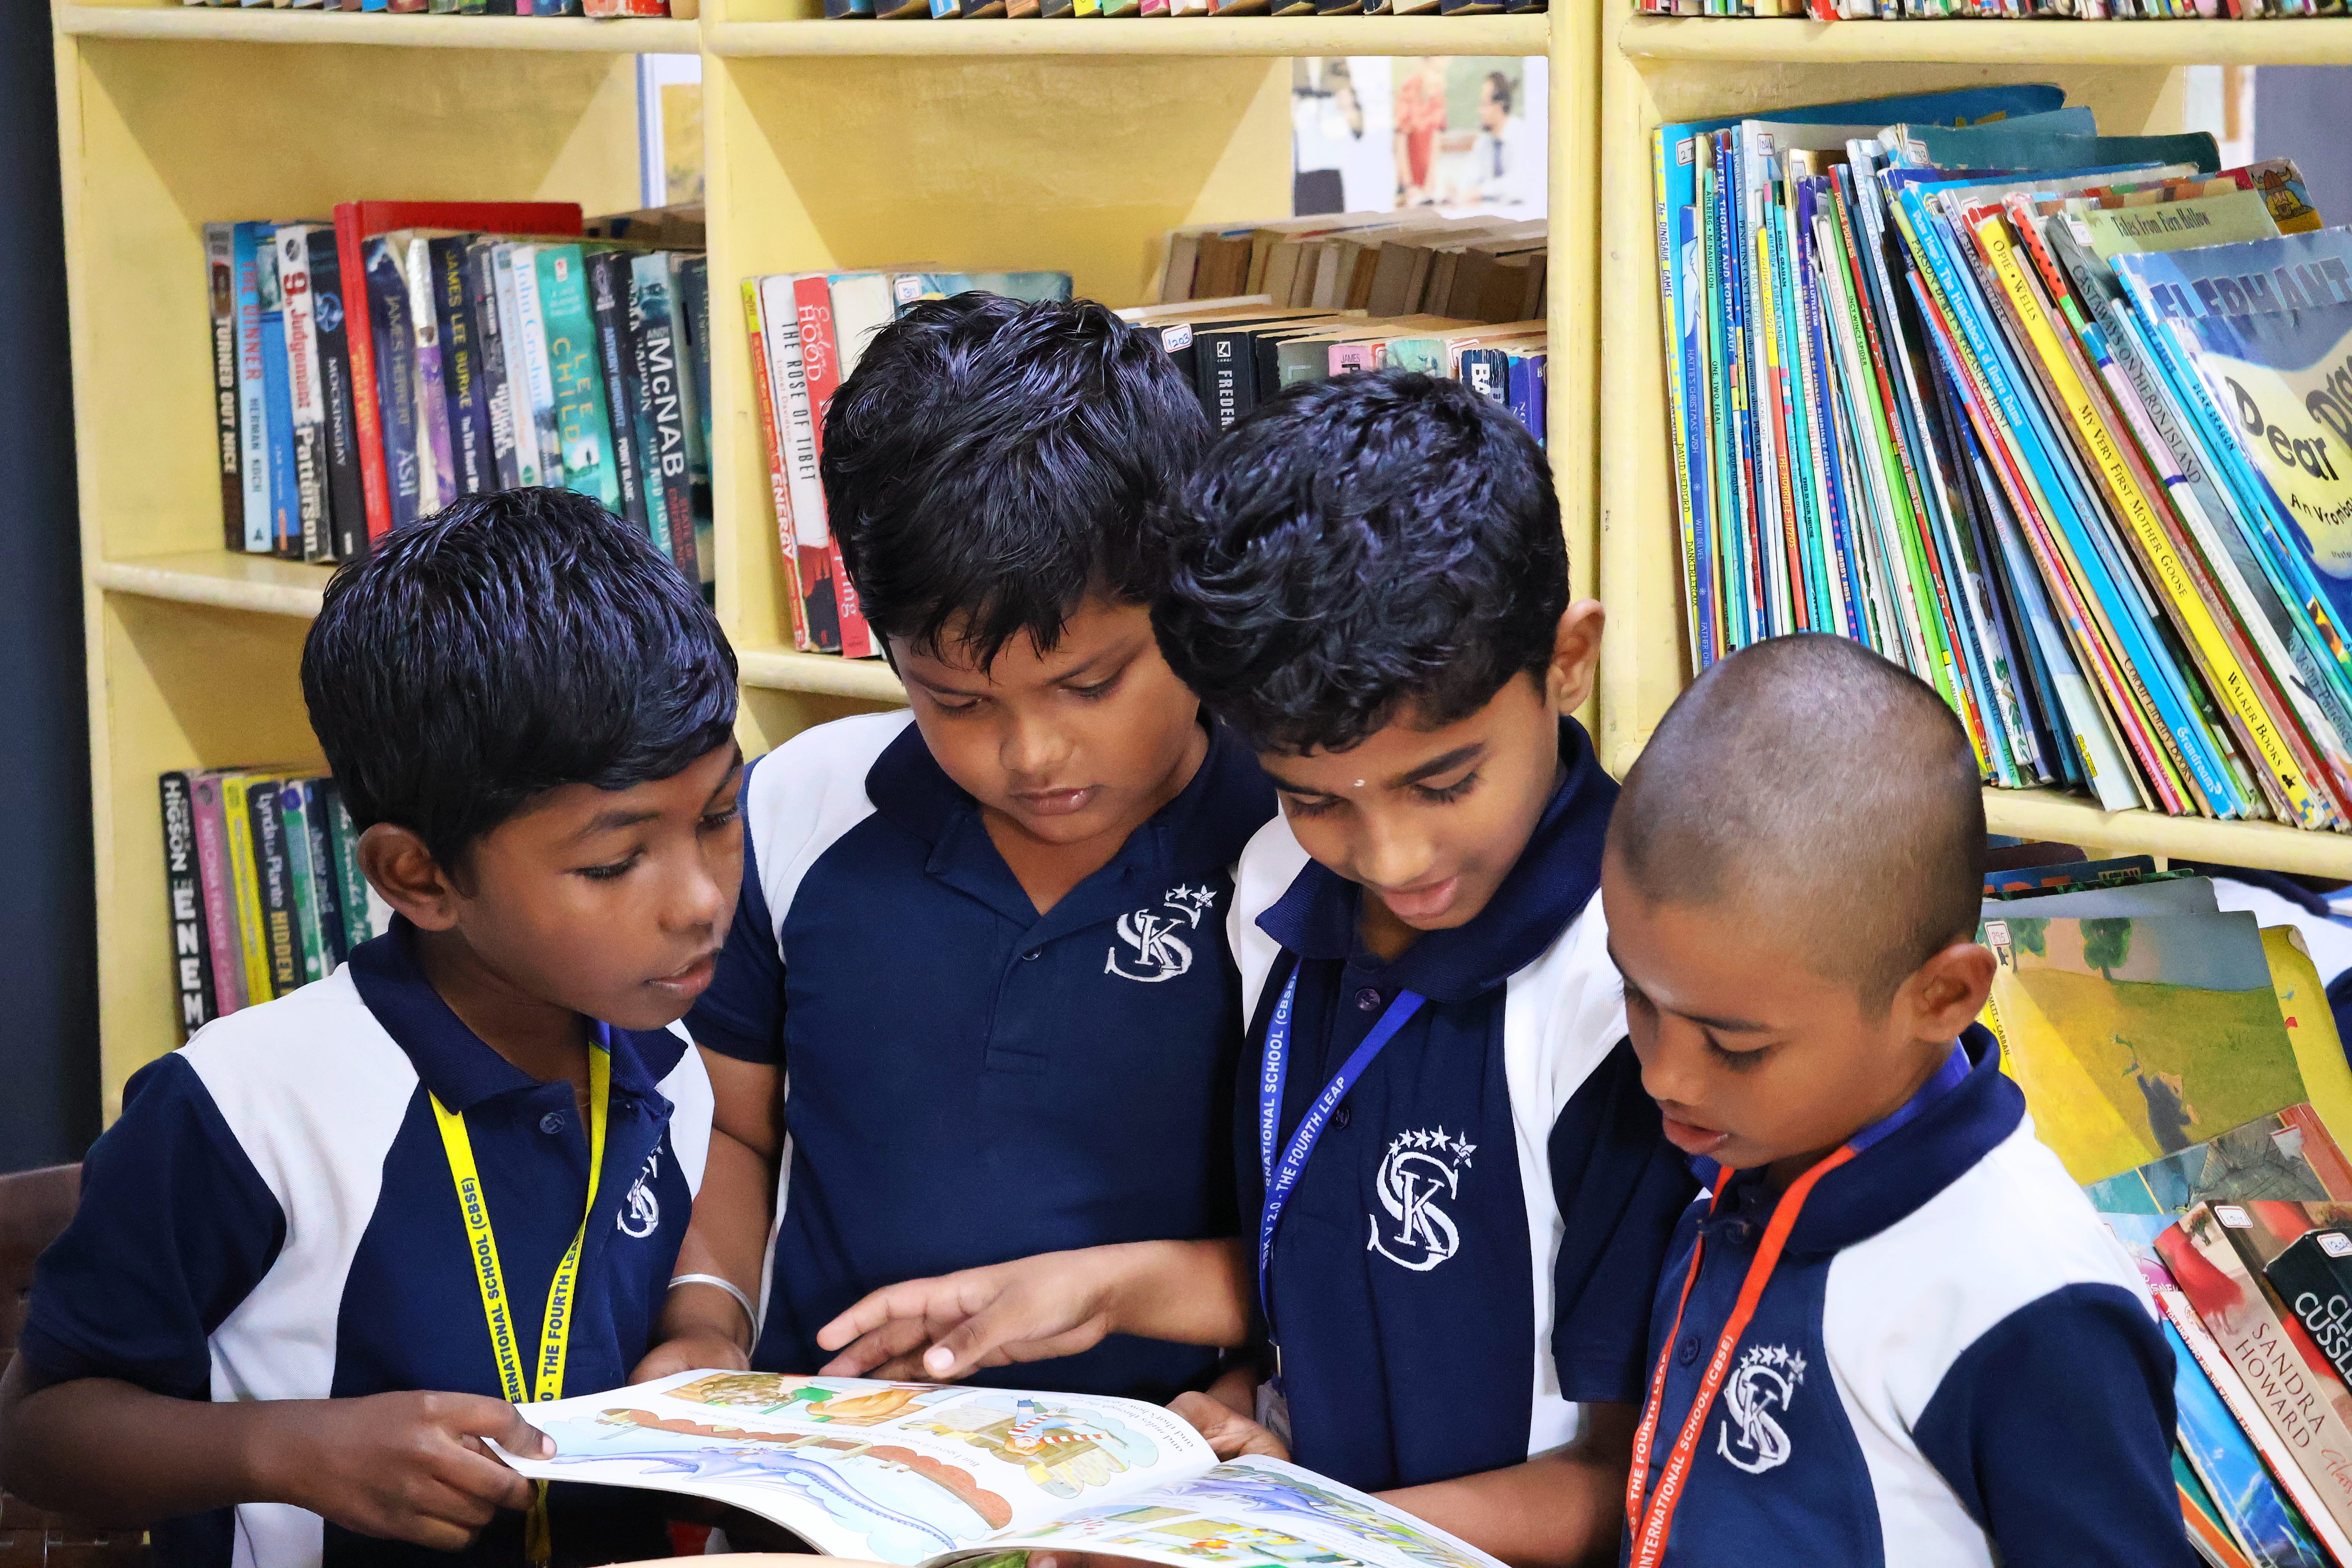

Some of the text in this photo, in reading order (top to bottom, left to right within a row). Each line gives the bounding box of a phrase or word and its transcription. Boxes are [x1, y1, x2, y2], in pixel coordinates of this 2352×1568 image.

[1715, 146, 1726, 197] VALERIE
[1719, 201, 1729, 249] THOMAS
[1835, 192, 1848, 223] PUZZLE
[2111, 207, 2212, 237] Tales Hollow
[1657, 202, 1672, 298] The DINOSAUR GAMES
[1721, 253, 1731, 278] AND
[1739, 221, 1748, 266] PENGUINS
[1749, 244, 1758, 270] TREES
[1851, 160, 1898, 321] PUZZLE JOURNEY AROUND THE WORLD
[1724, 282, 1733, 322] KORKY
[1751, 273, 1759, 297] HAVE
[1768, 233, 1777, 268] WHYBROW
[1776, 316, 1785, 352] REYNOLDS
[1829, 263, 1849, 341] WILD BOARS COOK
[2013, 279, 2038, 321] WELLS
[2149, 256, 2352, 319] ELEPHANT
[243, 304, 263, 381] DINNER
[385, 295, 405, 351] JAMES
[445, 250, 472, 409] JAMES LEE BURKE
[798, 304, 823, 382] HOOD
[1168, 333, 1191, 348] 1203
[1727, 326, 1735, 352] PAUL
[1752, 299, 1761, 337] NEEDLES
[1850, 312, 1862, 339] WINCY
[1857, 341, 1867, 366] SPIDER
[1912, 240, 2011, 428] PARSON TREASURE HUNT
[574, 354, 593, 418] LEE
[1341, 353, 1360, 363] JAMES
[1688, 349, 1696, 384] HATTIE'S
[1951, 294, 2022, 427] Hunchback Dame
[2073, 265, 2122, 343] CASTAWAYS
[2133, 373, 2171, 426] HERON
[2164, 426, 2201, 483] ISLAND
[328, 357, 346, 466] MOCKINGJAY
[553, 337, 581, 443] CHILD
[646, 338, 685, 478] McNAB
[777, 359, 792, 443] Lionel Davidson
[782, 321, 817, 481] THE ROSE OF TIBET
[1689, 386, 1699, 432] CHRISTMAS
[1799, 341, 1821, 470] GOLDILOCKS AND THE THREE BEARS
[2192, 383, 2210, 411] DEAR
[1816, 407, 1832, 477] MIDNIGHT FEAST
[1911, 397, 1931, 447] LESLEY SIMS
[1989, 422, 2001, 439] BUS
[2224, 375, 2339, 481] Dear
[397, 449, 417, 497] ASH
[1677, 443, 1691, 513] DAVID BEDFORD
[1778, 453, 1795, 548] THE HORRIBLE HIPPOS
[771, 473, 794, 559] ENERGY
[1739, 485, 1748, 543] DINOSAUR
[2291, 493, 2312, 518] An
[1837, 550, 1851, 602] MADDY ROSE
[2078, 405, 2283, 768] MY VERY FIRST MOTHER GOOSE WALKER BOOKS
[1701, 622, 1710, 650] FATHER
[1949, 679, 1961, 713] BAREFOOT
[1960, 673, 1974, 704] USBORNE
[1998, 699, 2014, 738] USBORNE
[163, 780, 188, 872] HIGSON
[271, 910, 294, 982] HIDDEN
[1997, 1024, 2010, 1056] CABBAN
[1261, 974, 1297, 1189] RNATIONAL SCHOOL (CBSE)
[1266, 1077, 1346, 1225] 2.0 THE FOURTH LEAP
[461, 1177, 523, 1405] ERNATIONAL SCHOOL (CBSE)
[543, 1274, 571, 1377] THE FOURTH
[1679, 1335, 1733, 1452] SCHOOL (CBSE)
[2166, 1307, 2263, 1451] TOM AND PIPPO AND THE WASHING MACHINE
[2235, 1339, 2310, 1449] HOWARD
[2252, 1322, 2325, 1435] SANDRA
[1163, 1435, 1183, 1452] and
[1175, 1430, 1194, 1448] and
[1630, 1353, 1667, 1501] THE FOURTH LEAP
[962, 1457, 981, 1468] But
